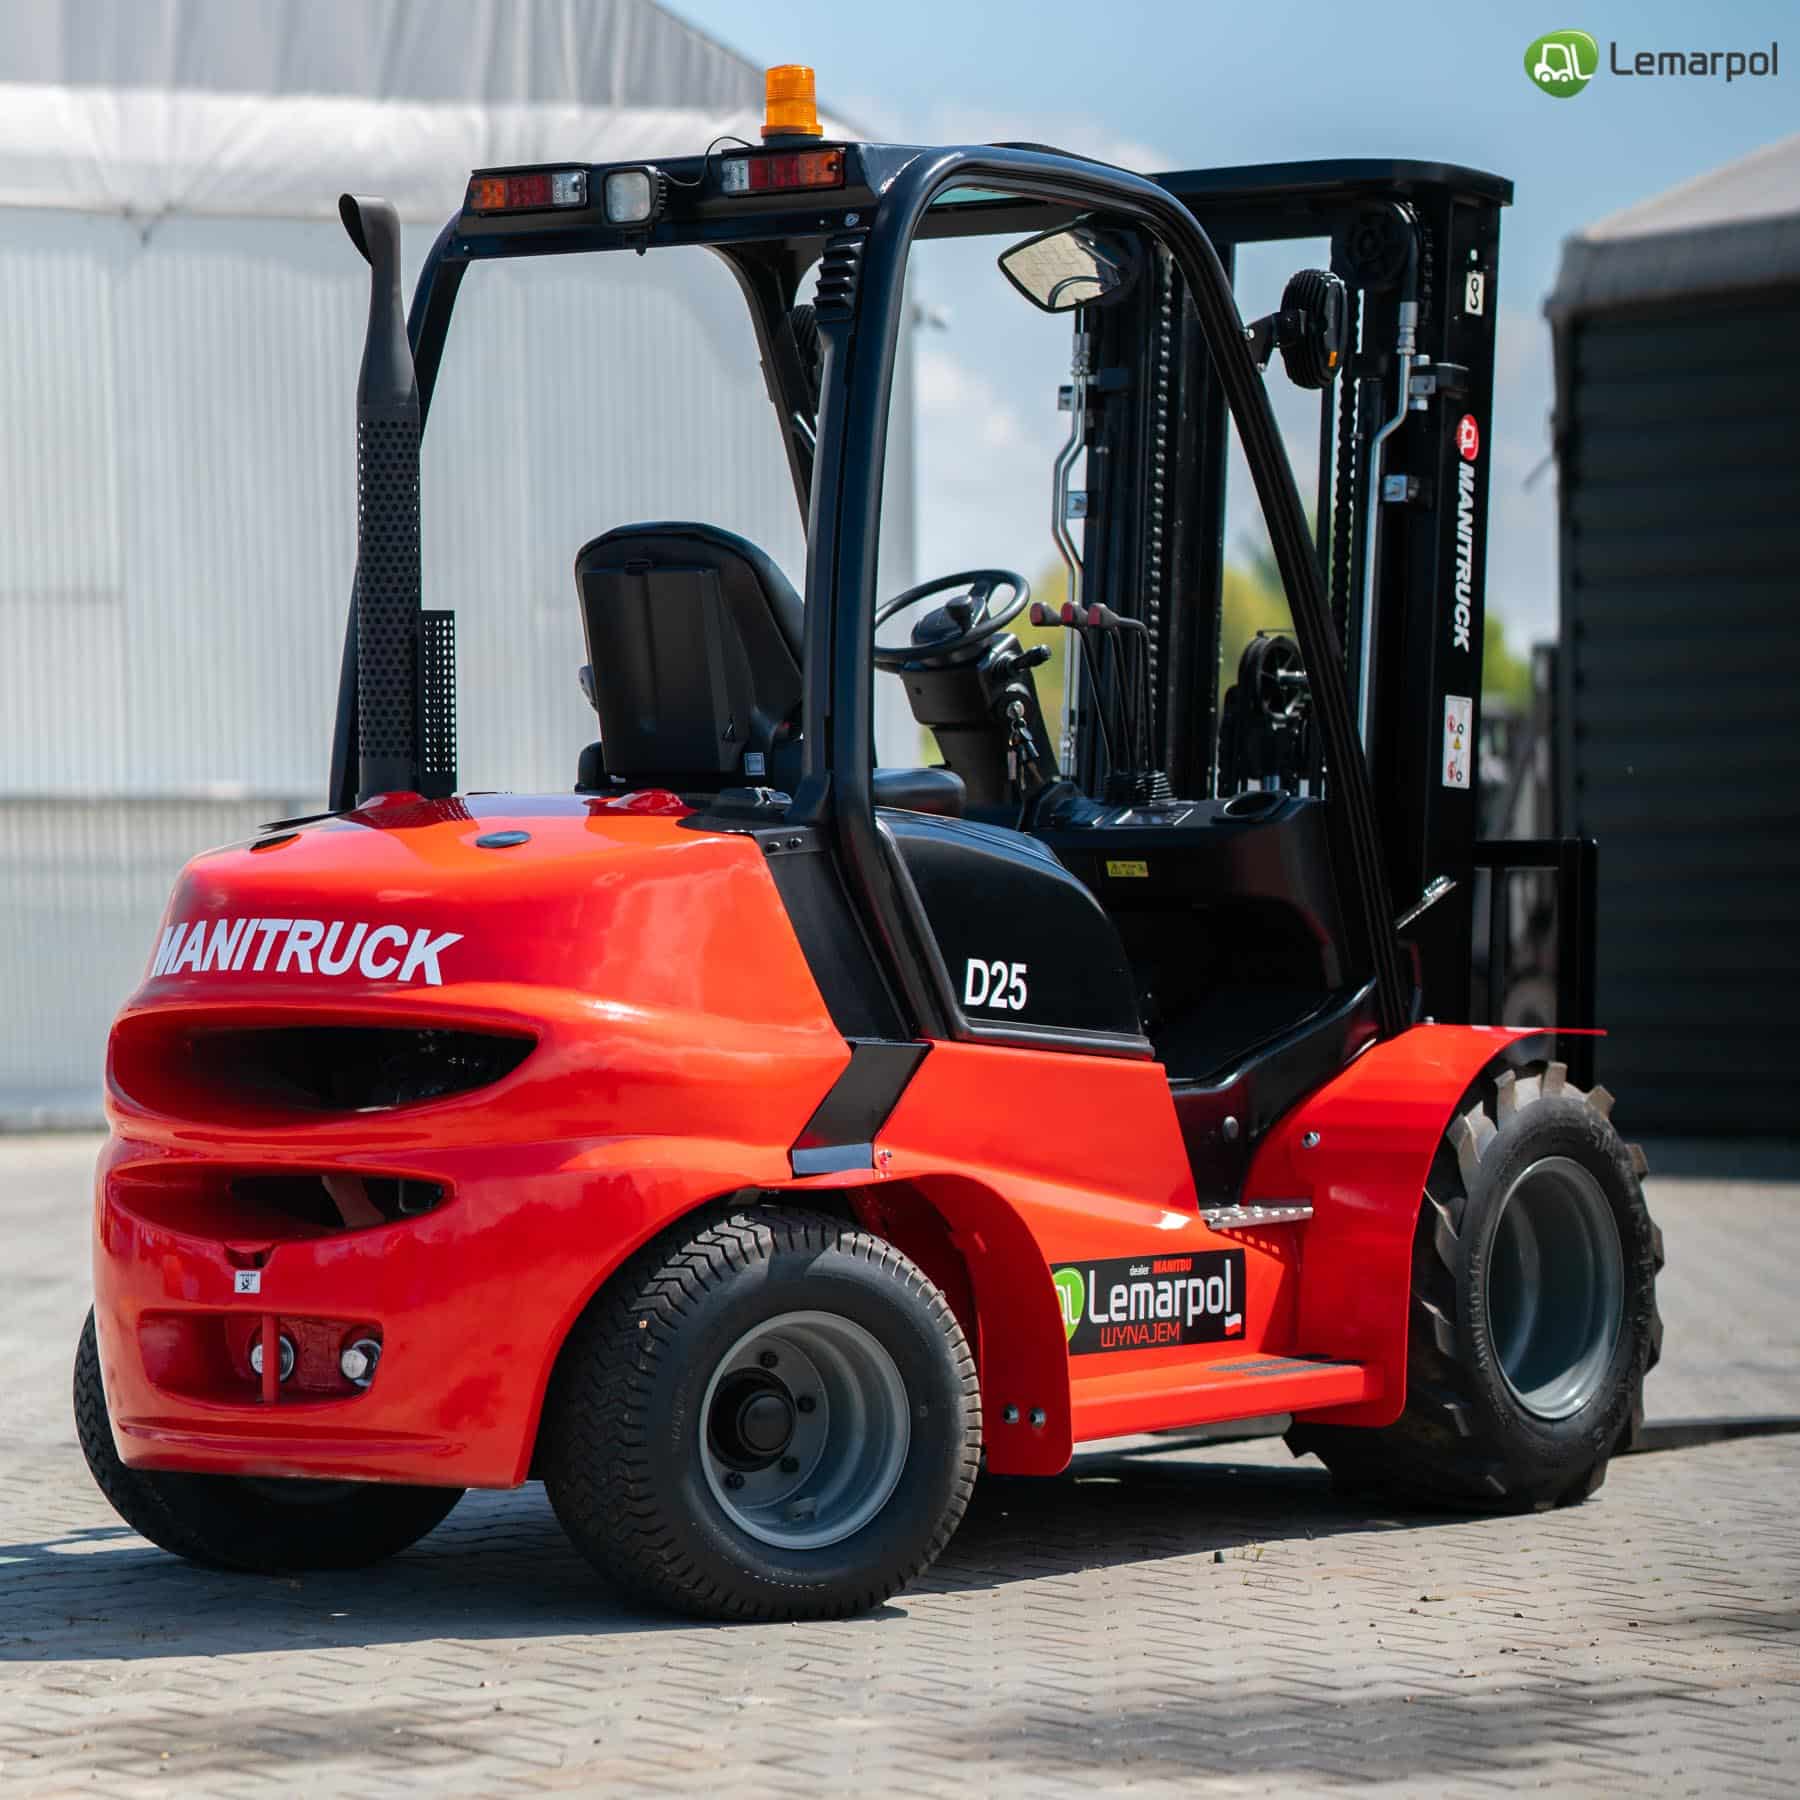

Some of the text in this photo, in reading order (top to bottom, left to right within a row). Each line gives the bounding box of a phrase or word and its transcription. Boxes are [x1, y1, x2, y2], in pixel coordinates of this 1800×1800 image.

[1453, 461, 1475, 653] MANITRUCK
[150, 918, 465, 986] MANITRUCK
[964, 958, 1028, 1011] D25
[1088, 1259, 1232, 1327] Lemarpol
[1101, 1321, 1180, 1347] WYNAJEM
